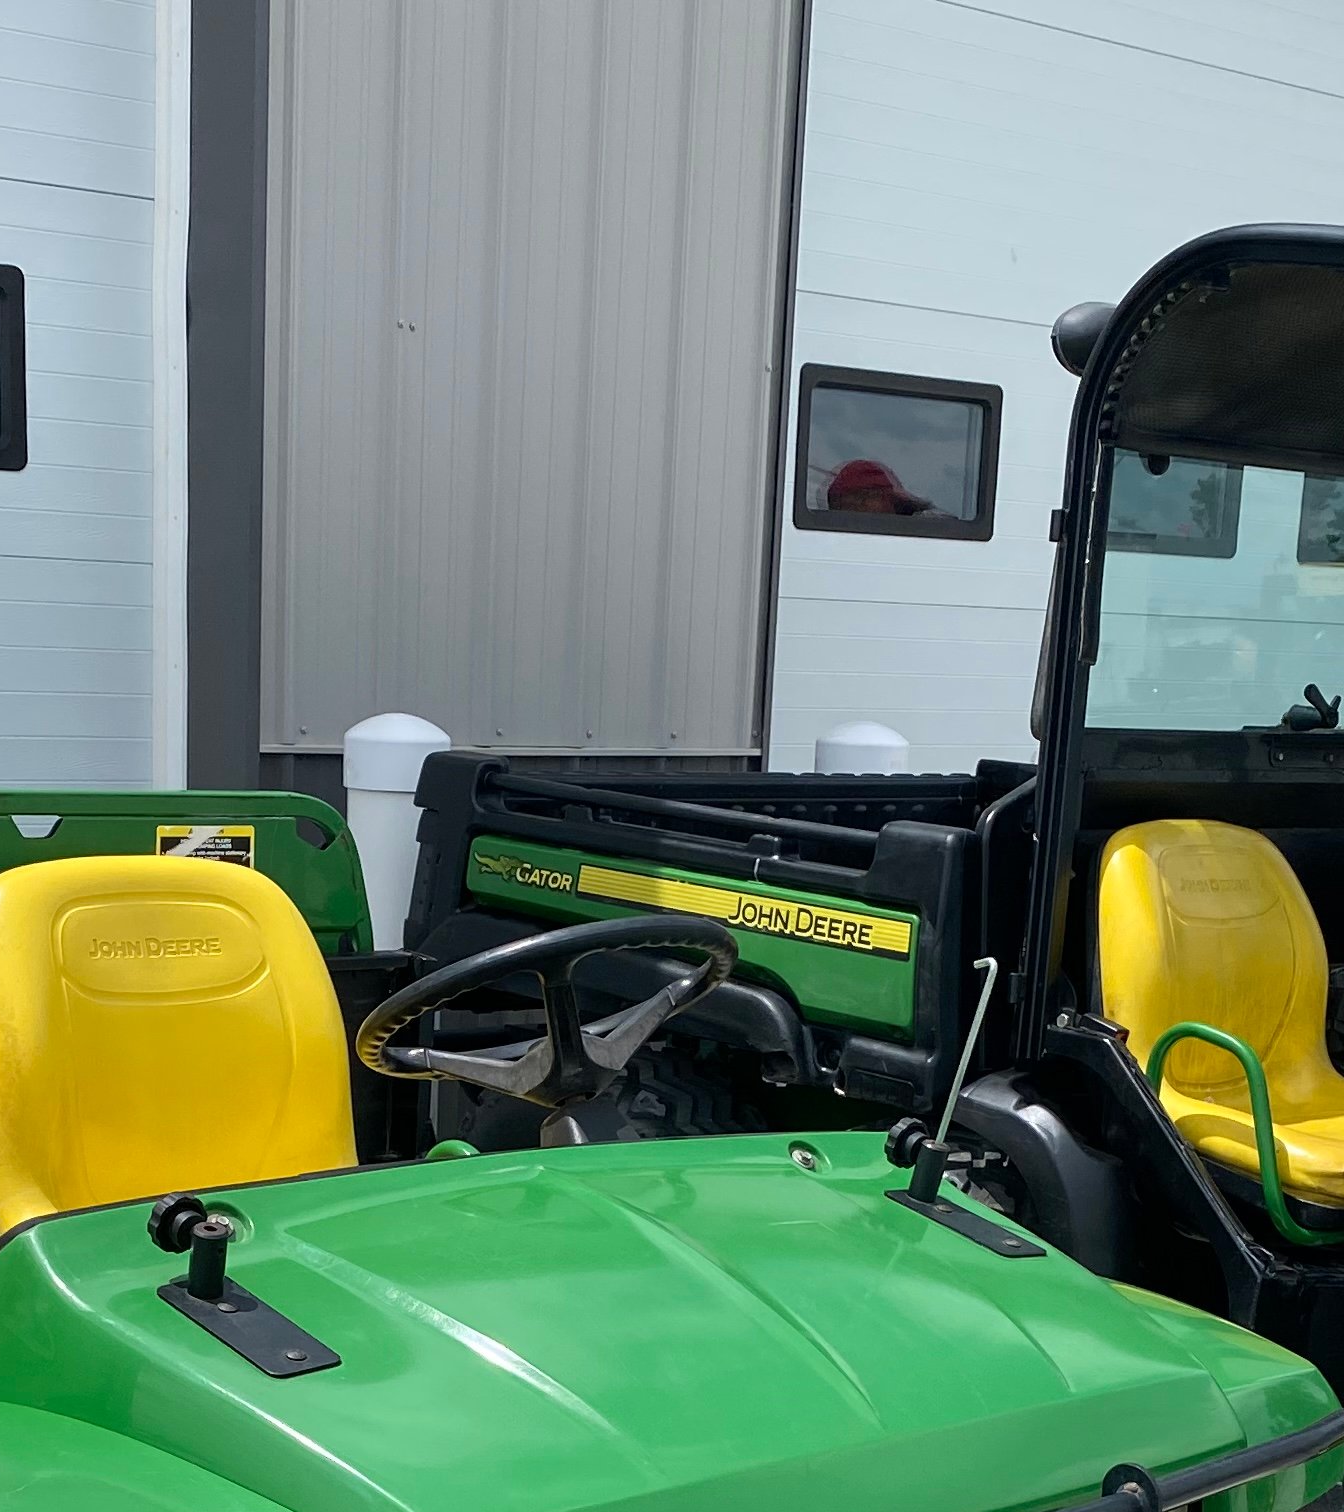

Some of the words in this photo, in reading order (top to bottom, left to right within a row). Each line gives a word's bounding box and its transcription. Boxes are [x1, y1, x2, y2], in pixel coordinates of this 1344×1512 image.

[516, 863, 573, 891] GATOR
[728, 896, 790, 931] JOHN
[795, 907, 873, 946] DEERE
[89, 938, 143, 959] JOHN
[145, 937, 223, 958] DEERE
